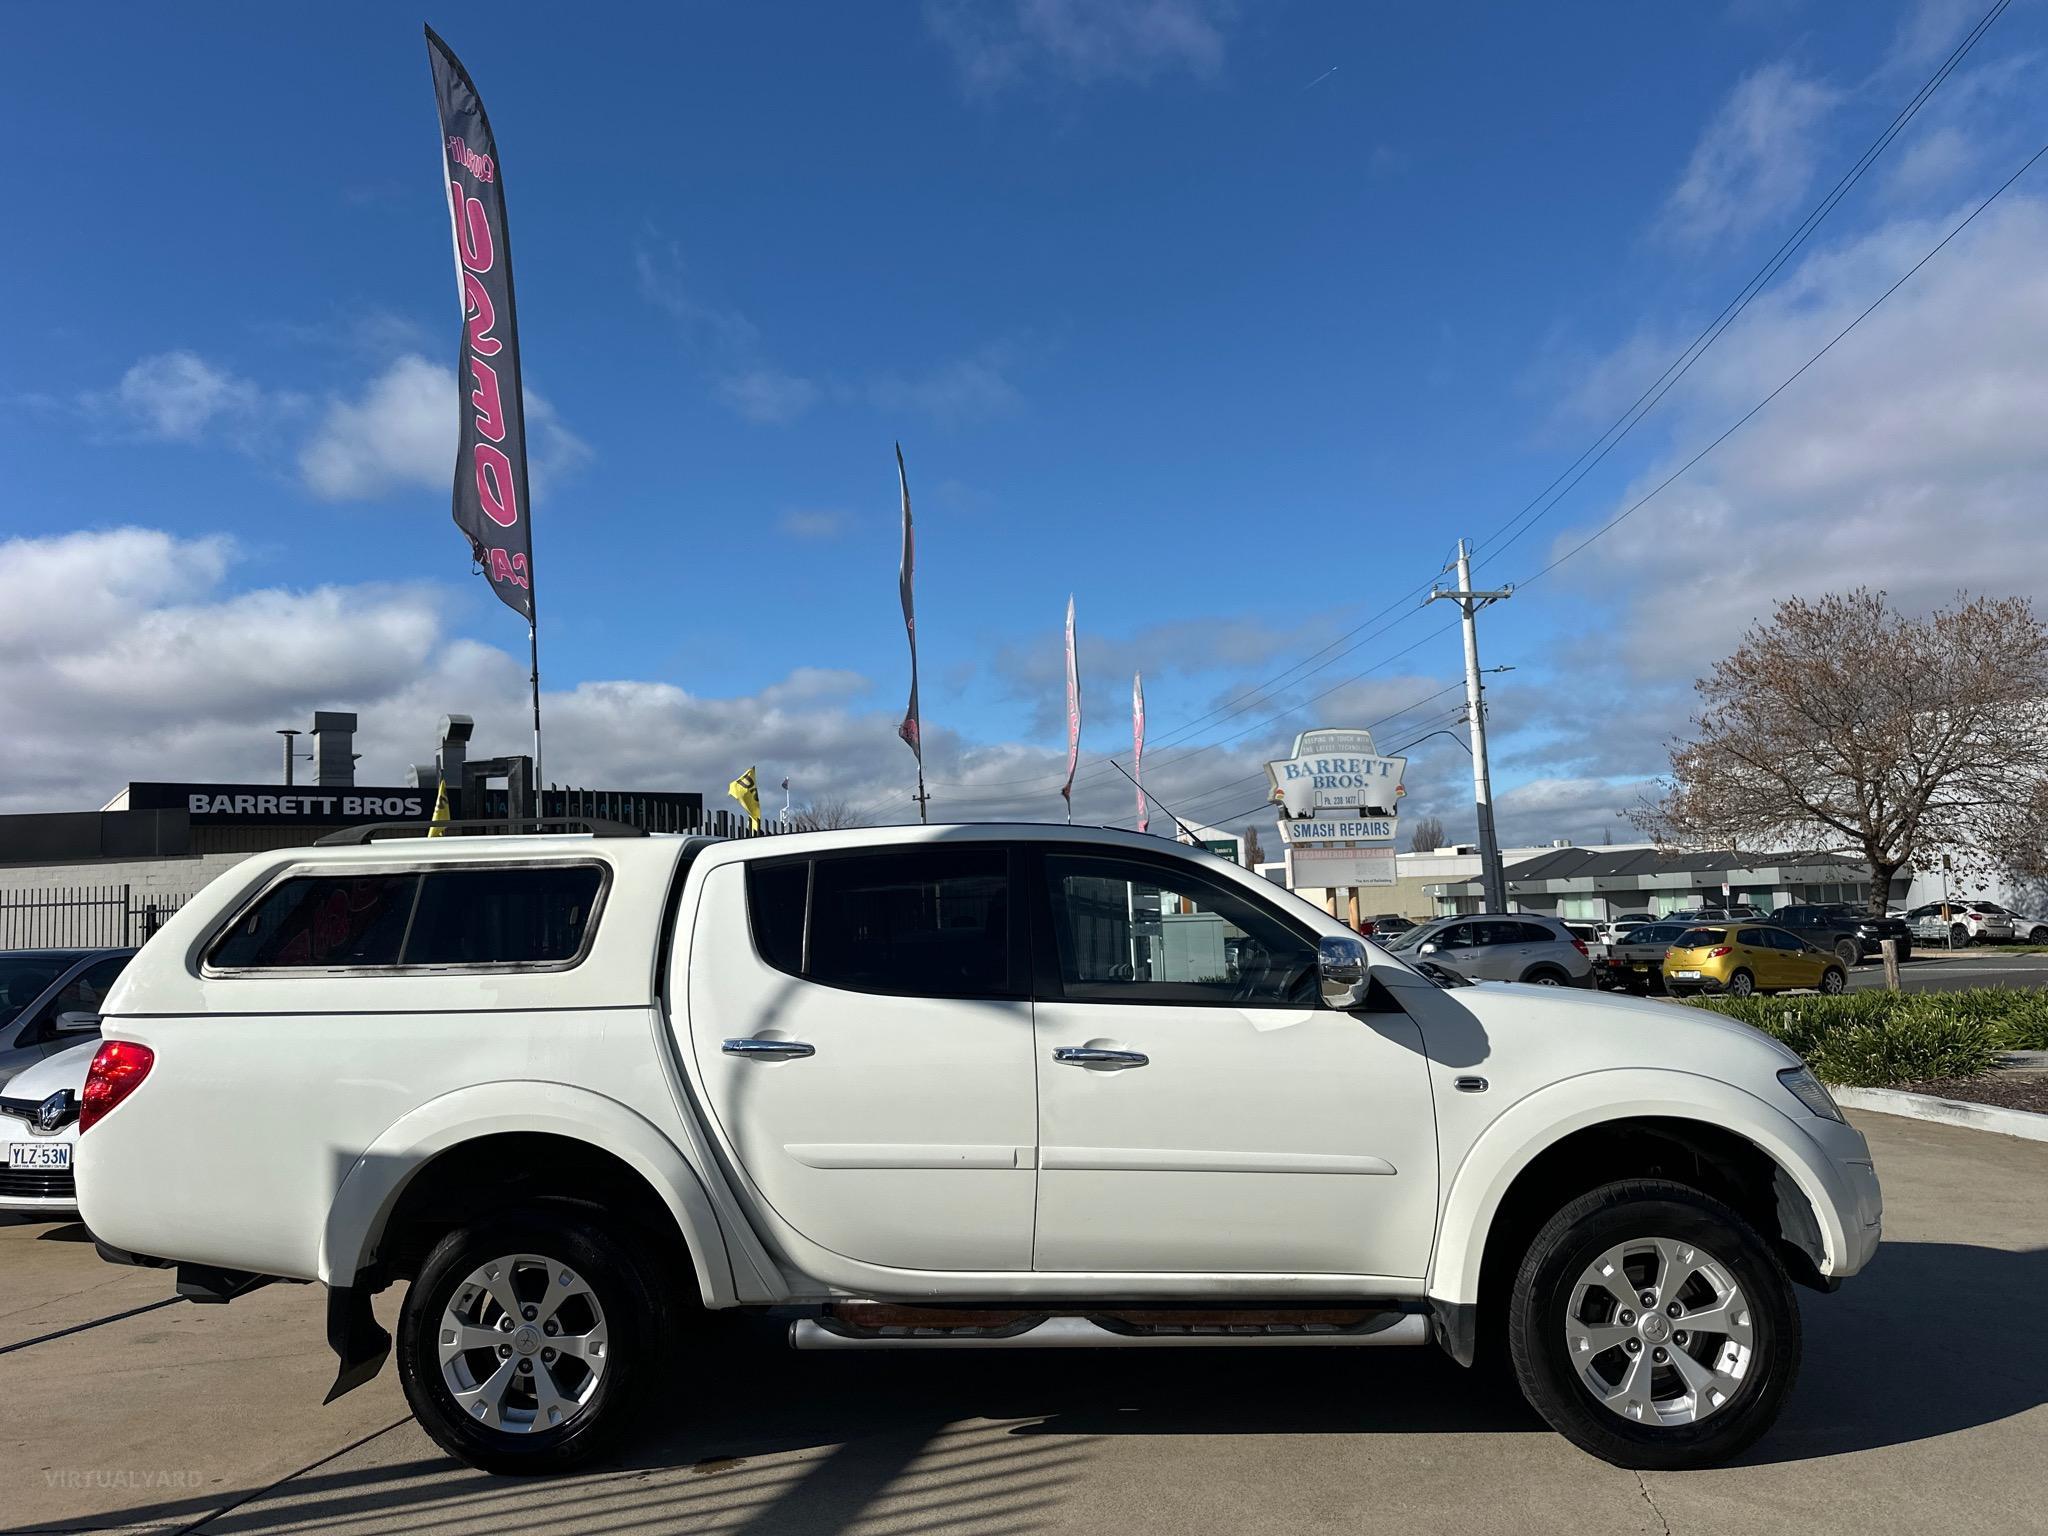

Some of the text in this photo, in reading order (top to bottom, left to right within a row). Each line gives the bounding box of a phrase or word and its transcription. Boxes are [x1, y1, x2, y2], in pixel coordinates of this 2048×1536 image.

[1284, 759, 1393, 780] BARRETT
[1312, 774, 1369, 789] BROS.
[189, 794, 338, 815] BARRETT
[342, 797, 422, 816] BROS
[1293, 822, 1390, 838] SMASH REPAIRS
